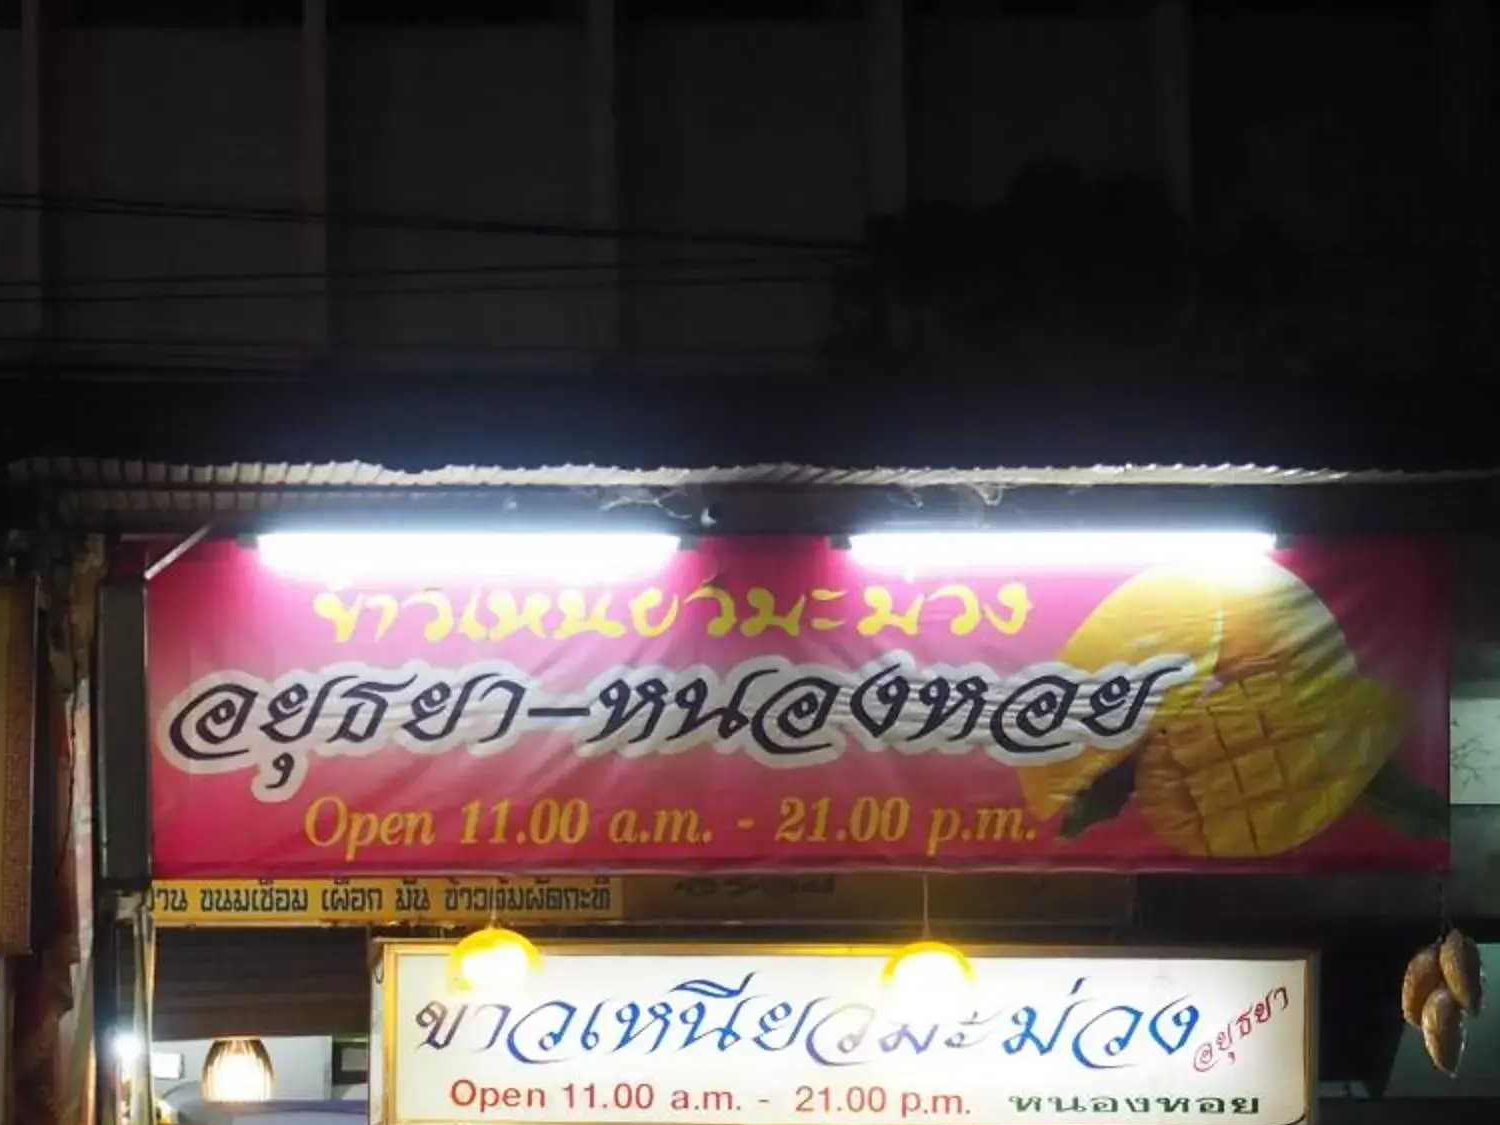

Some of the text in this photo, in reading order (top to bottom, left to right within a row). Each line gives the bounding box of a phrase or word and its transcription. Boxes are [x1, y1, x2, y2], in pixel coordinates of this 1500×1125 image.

[303, 797, 435, 861] Open
[462, 798, 590, 846] 11.00
[607, 808, 714, 846] a.m.
[774, 795, 910, 845] 21.00
[925, 806, 1039, 856] p.m.
[413, 970, 1202, 1070] ขาวเหนียวมะม่วง
[450, 1079, 545, 1113] Open
[562, 1081, 655, 1110] 11.00
[670, 1088, 742, 1112] a.m.
[794, 1085, 889, 1114] 21.00
[899, 1091, 972, 1120] p.m.
[1008, 1089, 1260, 1117] หนองหอย
